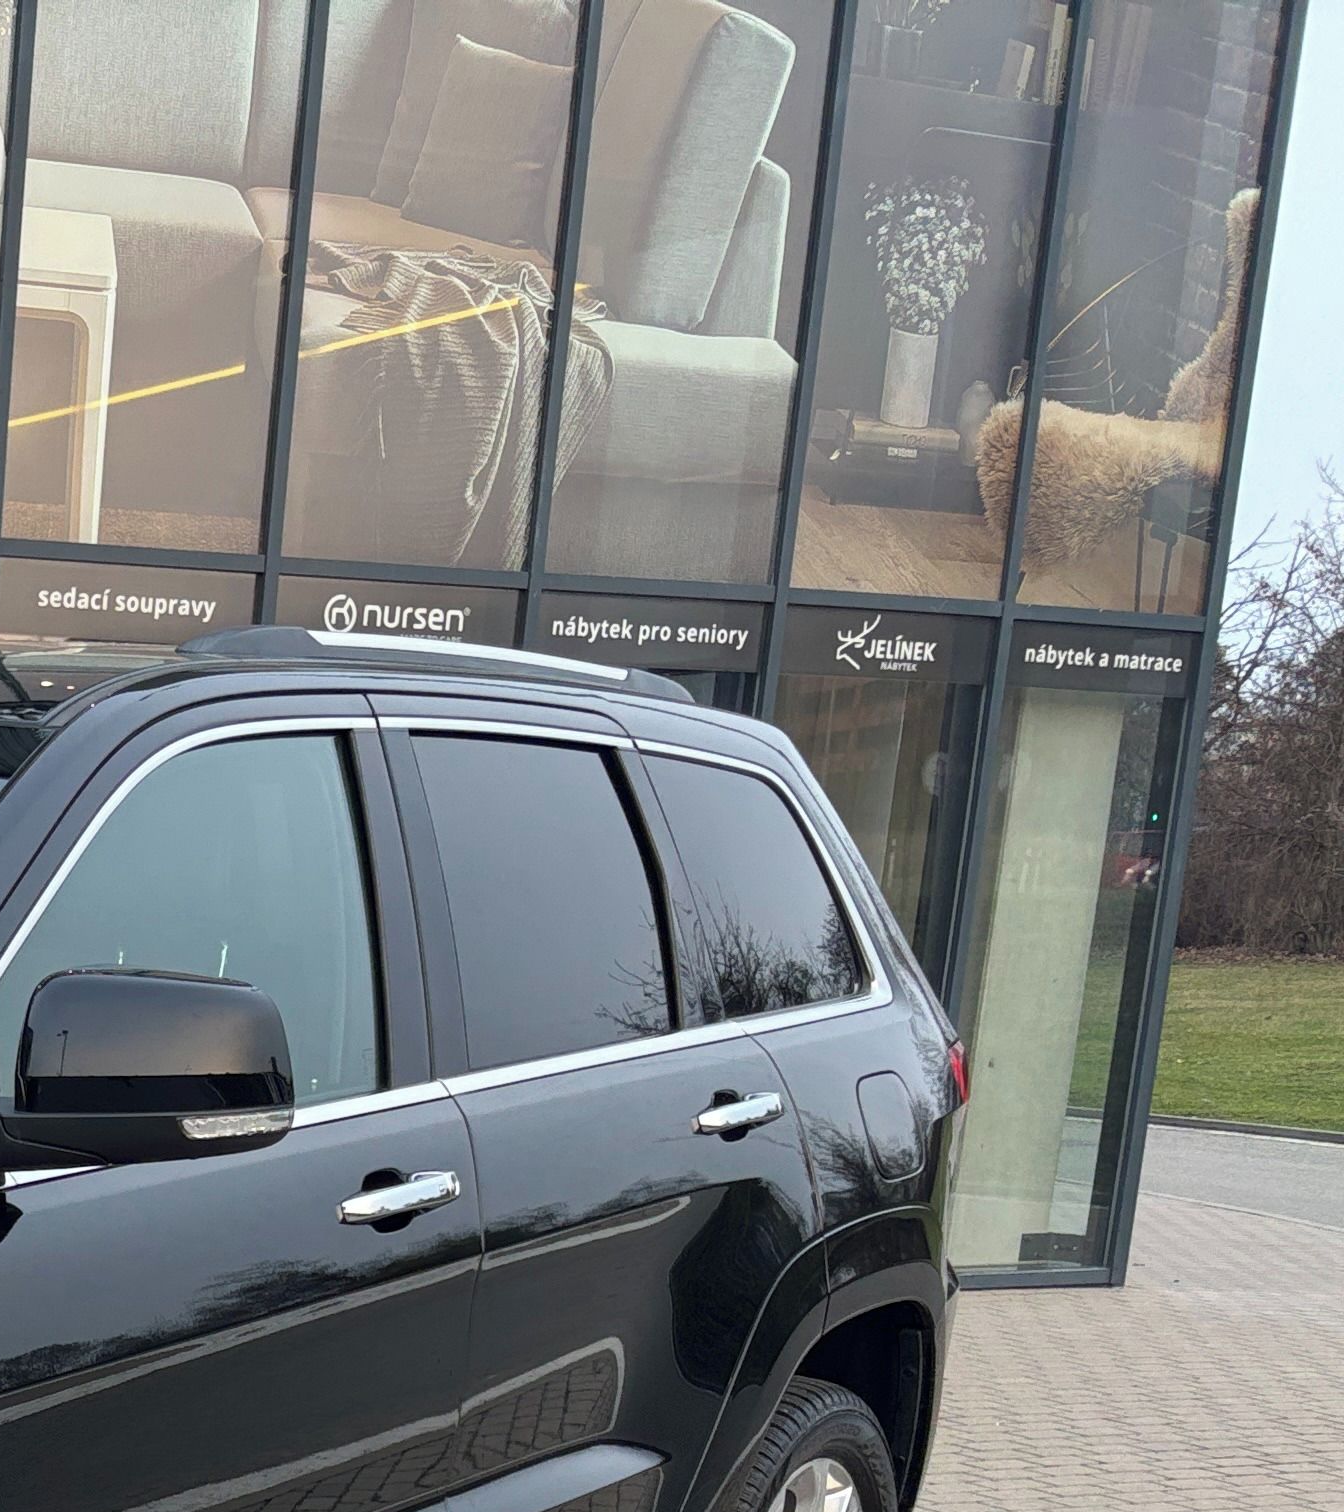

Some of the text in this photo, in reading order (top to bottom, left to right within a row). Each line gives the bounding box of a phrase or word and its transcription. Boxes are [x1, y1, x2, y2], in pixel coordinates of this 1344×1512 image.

[37, 586, 217, 623] sedací soupravy
[362, 604, 464, 632] nursen
[552, 615, 749, 651] nábytek pro seniory
[864, 633, 937, 663] JELÍNEK
[1024, 644, 1184, 673] nábytek a matrace
[880, 660, 918, 672] NÁBYTEK
